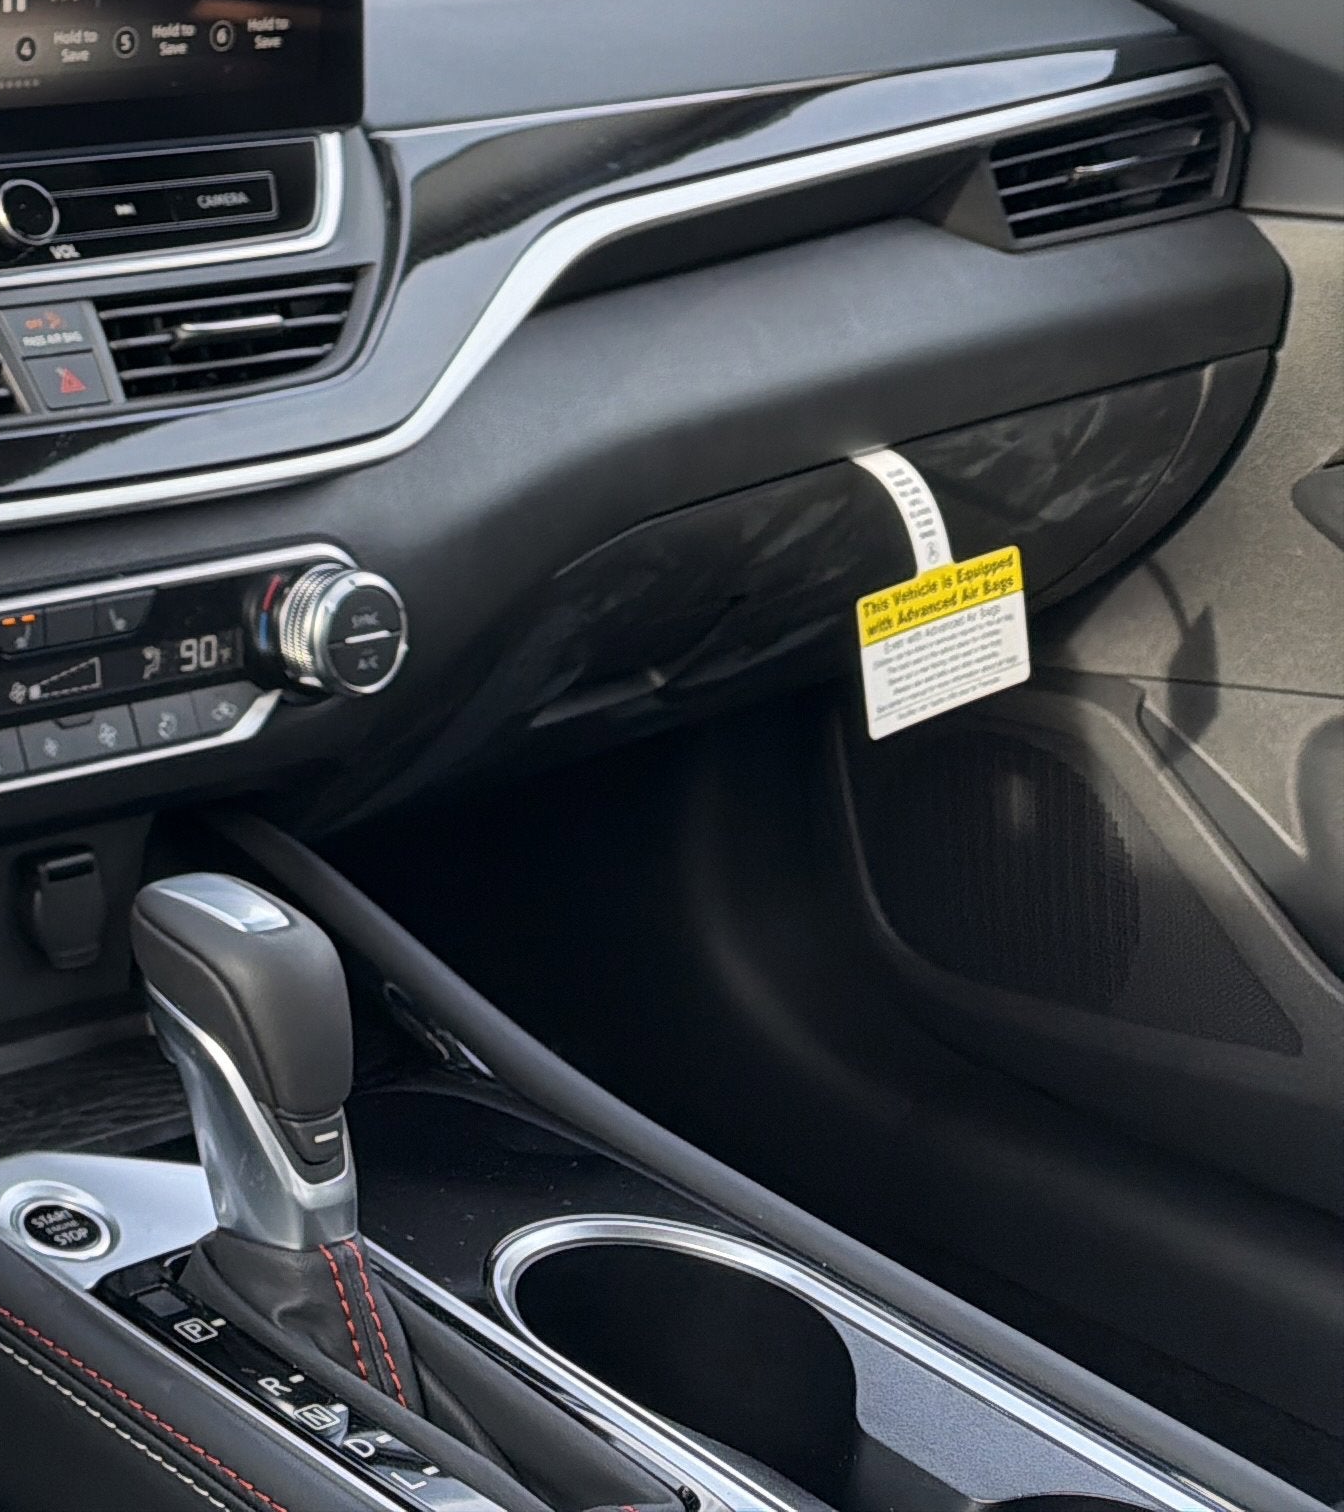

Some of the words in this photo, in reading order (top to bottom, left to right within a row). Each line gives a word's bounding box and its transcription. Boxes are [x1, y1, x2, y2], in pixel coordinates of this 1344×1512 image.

[152, 22, 180, 38] Hold
[247, 16, 274, 32] Hold
[197, 191, 250, 209] CAMERA
[863, 597, 889, 617] This
[891, 580, 938, 605] Vehicle
[956, 553, 1013, 583] Equipped
[897, 590, 957, 626] Advanced
[54, 1227, 89, 1246] STOP
[258, 1376, 292, 1398] R
[344, 1438, 376, 1458] D
[390, 1471, 426, 1490] L
